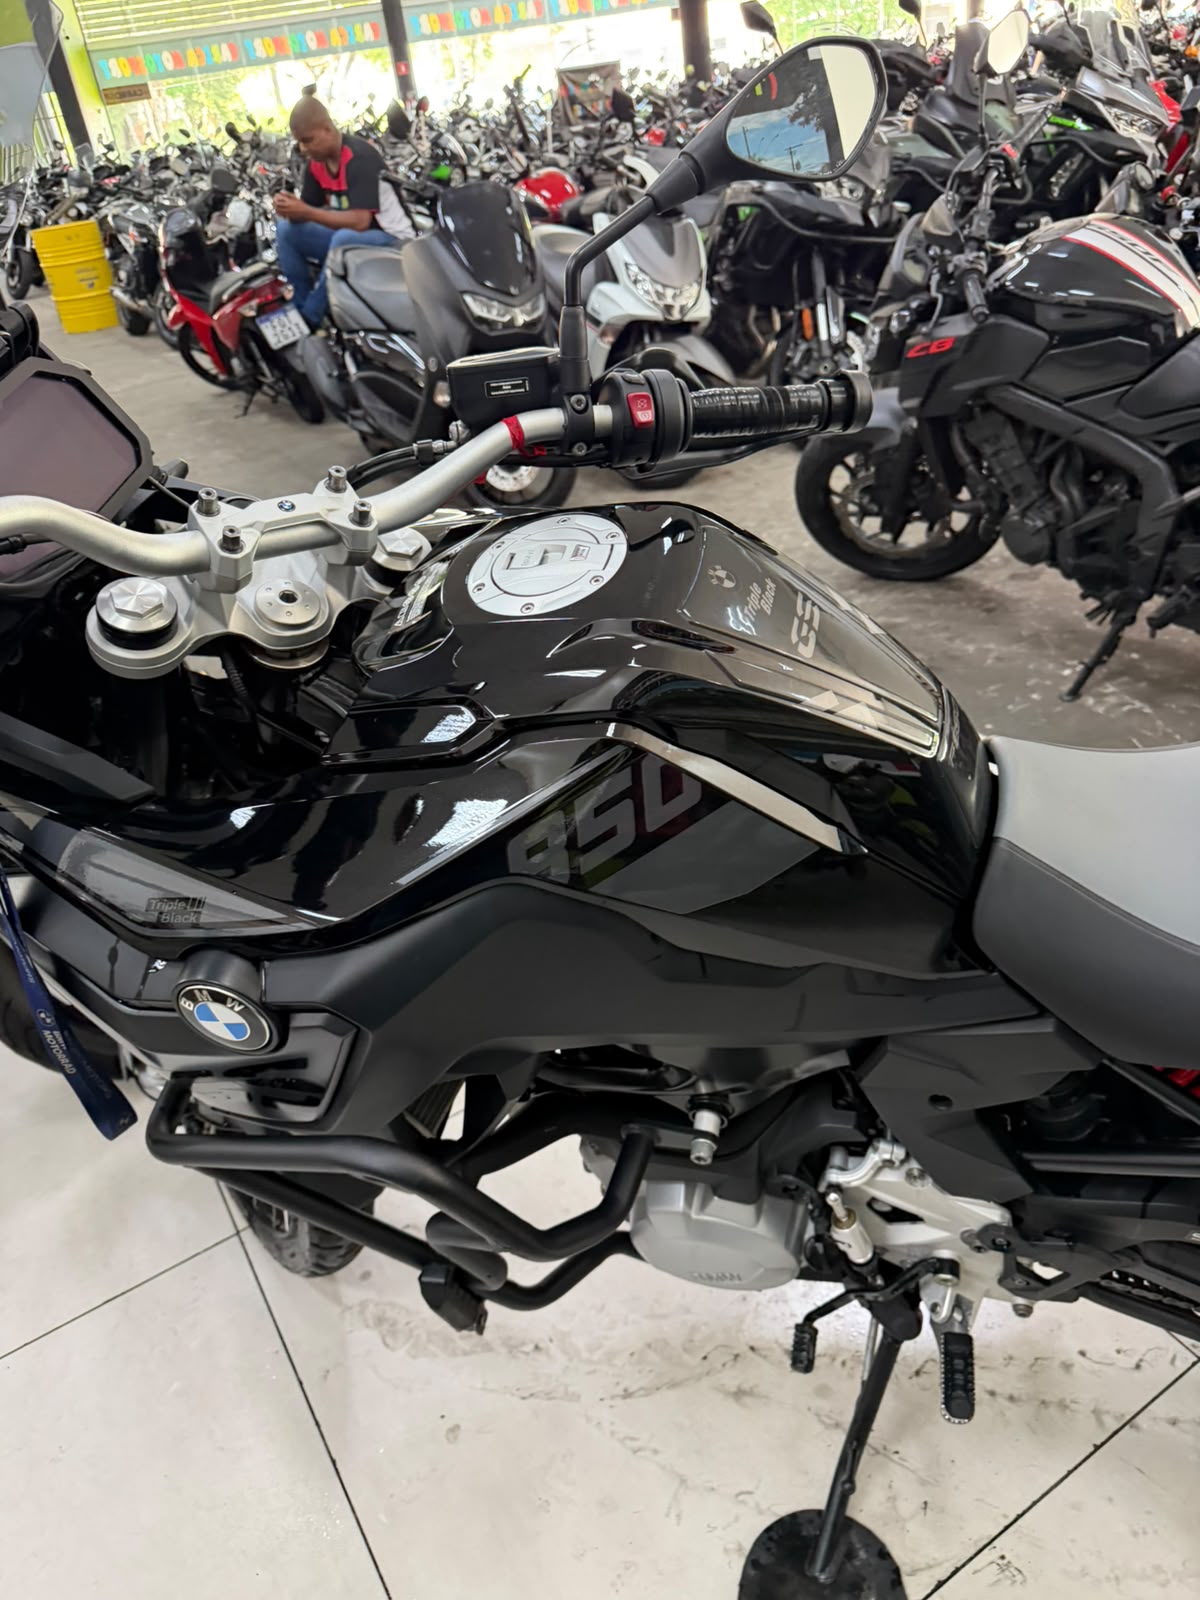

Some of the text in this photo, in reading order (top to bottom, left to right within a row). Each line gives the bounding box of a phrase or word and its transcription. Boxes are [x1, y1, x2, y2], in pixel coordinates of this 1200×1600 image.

[905, 336, 956, 358] CB
[744, 582, 761, 621] Triple
[760, 577, 777, 615] Black
[790, 591, 820, 659] GS
[150, 898, 187, 911] Triple
[160, 912, 199, 924] Black
[180, 989, 245, 1012] BMW
[42, 1029, 77, 1075] MOTORRAD
